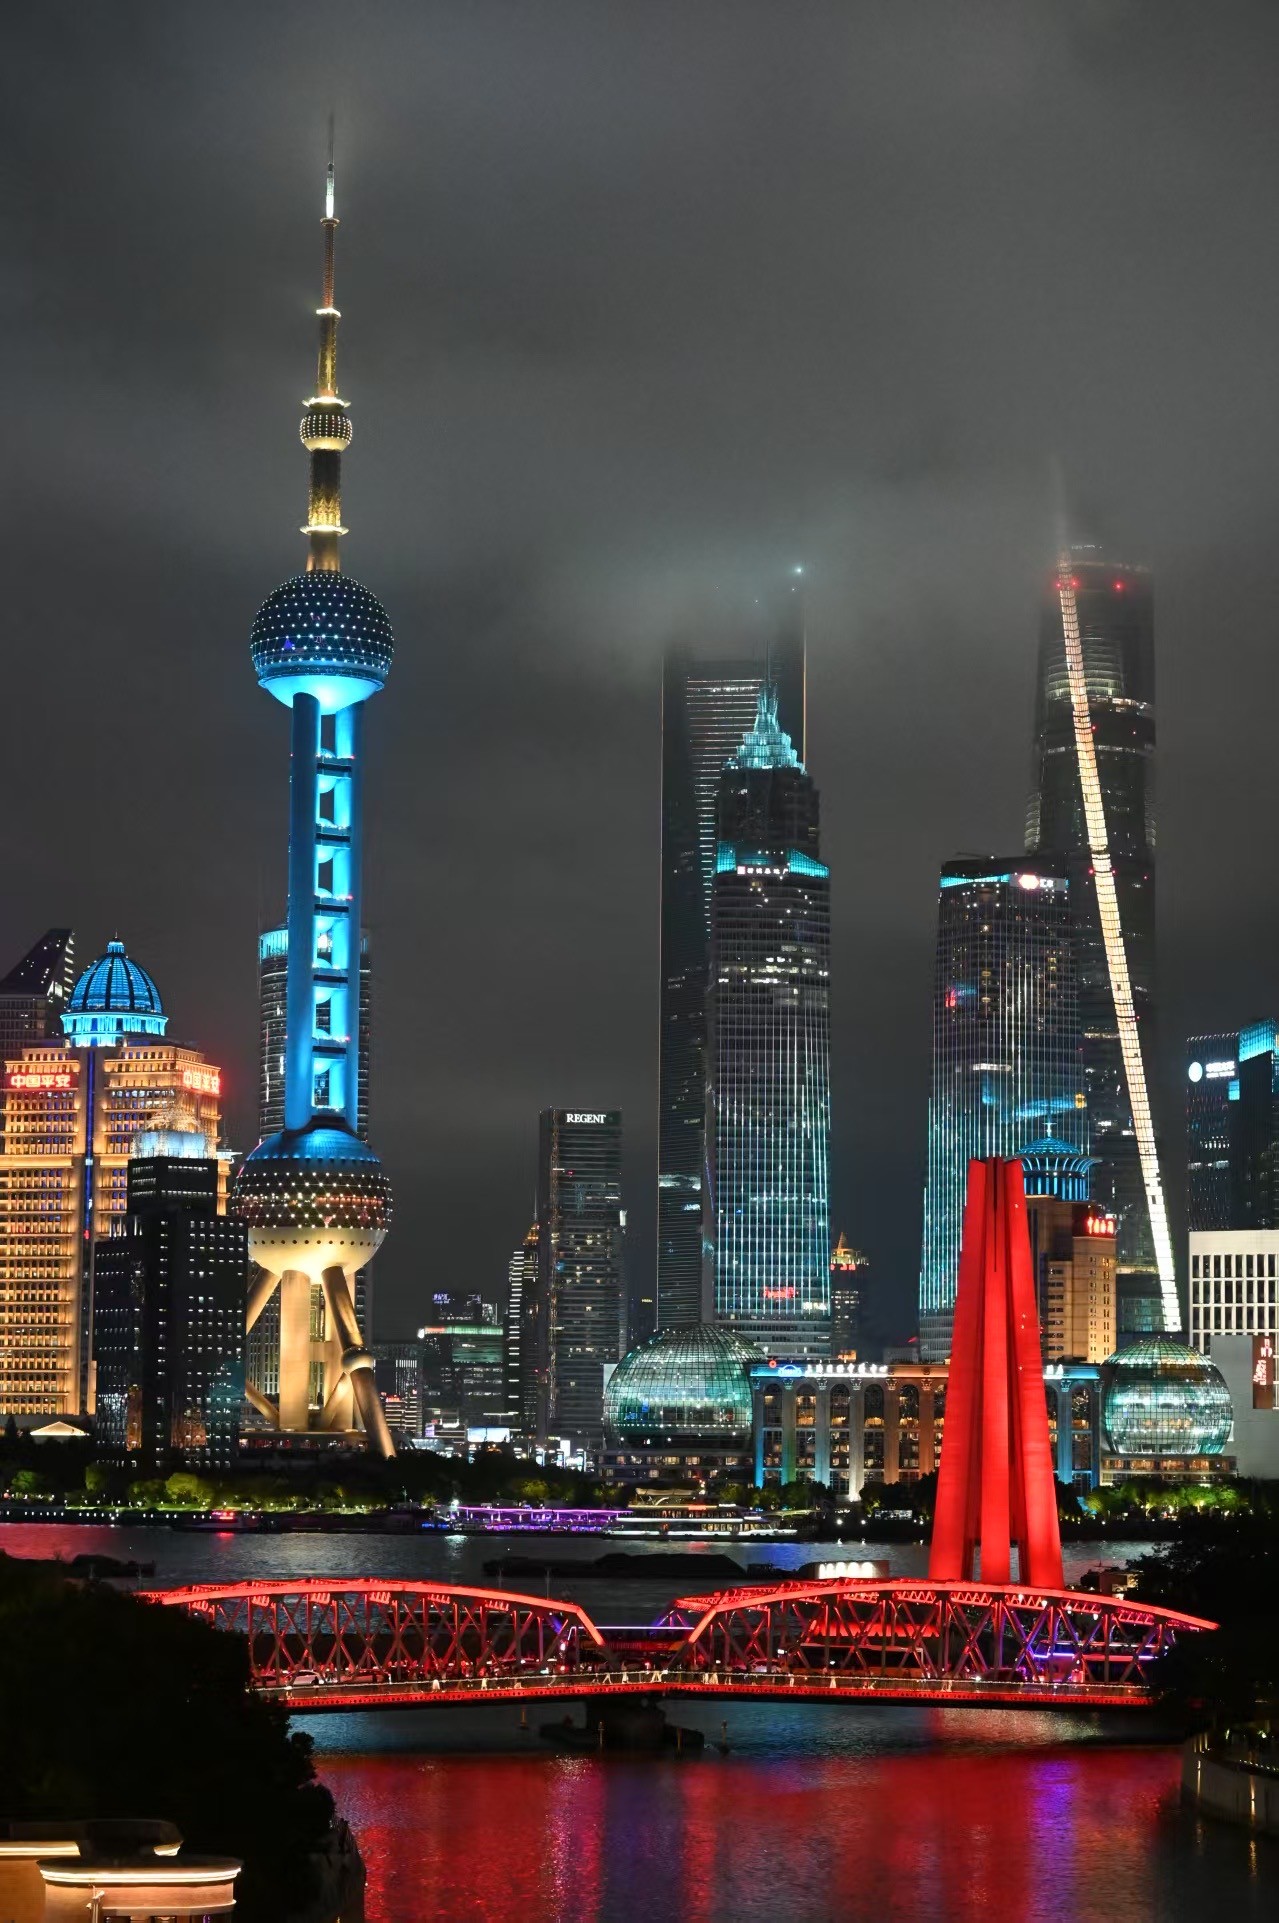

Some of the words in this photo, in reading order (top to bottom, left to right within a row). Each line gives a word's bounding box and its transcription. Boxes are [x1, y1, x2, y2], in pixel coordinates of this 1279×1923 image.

[10, 1073, 71, 1088] 中国平安
[182, 1070, 220, 1094] 中国平安
[566, 1113, 607, 1124] REGENT
